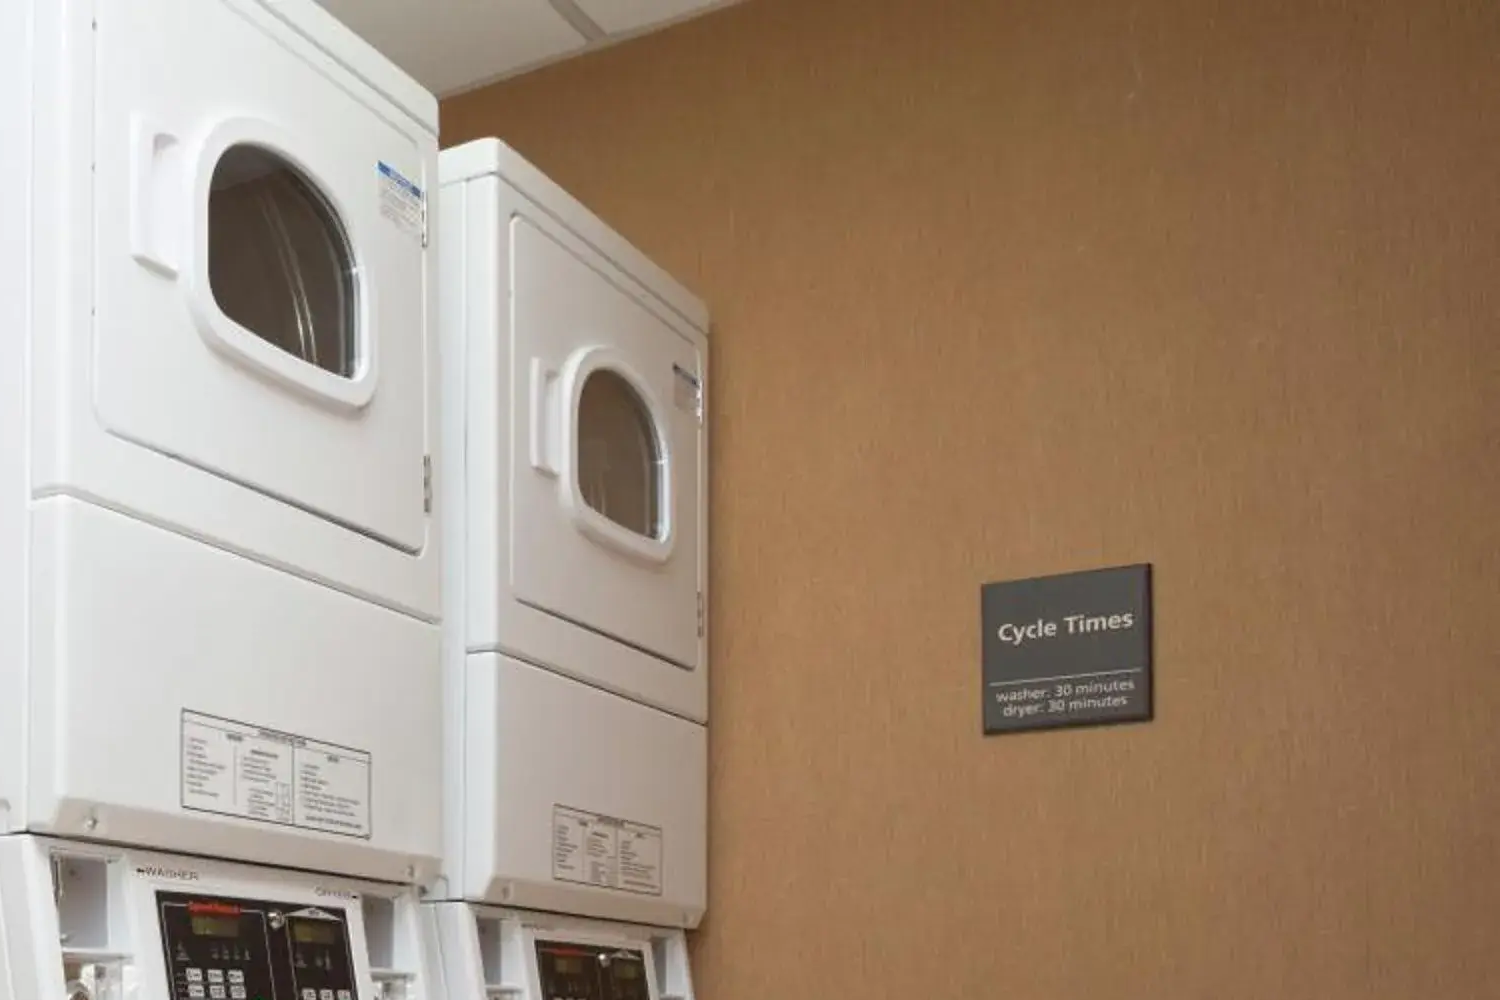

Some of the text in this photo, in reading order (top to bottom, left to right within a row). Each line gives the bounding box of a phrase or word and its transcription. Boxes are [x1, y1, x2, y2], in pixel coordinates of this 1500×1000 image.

[997, 612, 1134, 645] Cycle Times
[1054, 684, 1073, 698] 30
[1075, 679, 1136, 696] minutes
[1047, 699, 1065, 713] 30
[1068, 694, 1129, 711] minutes
